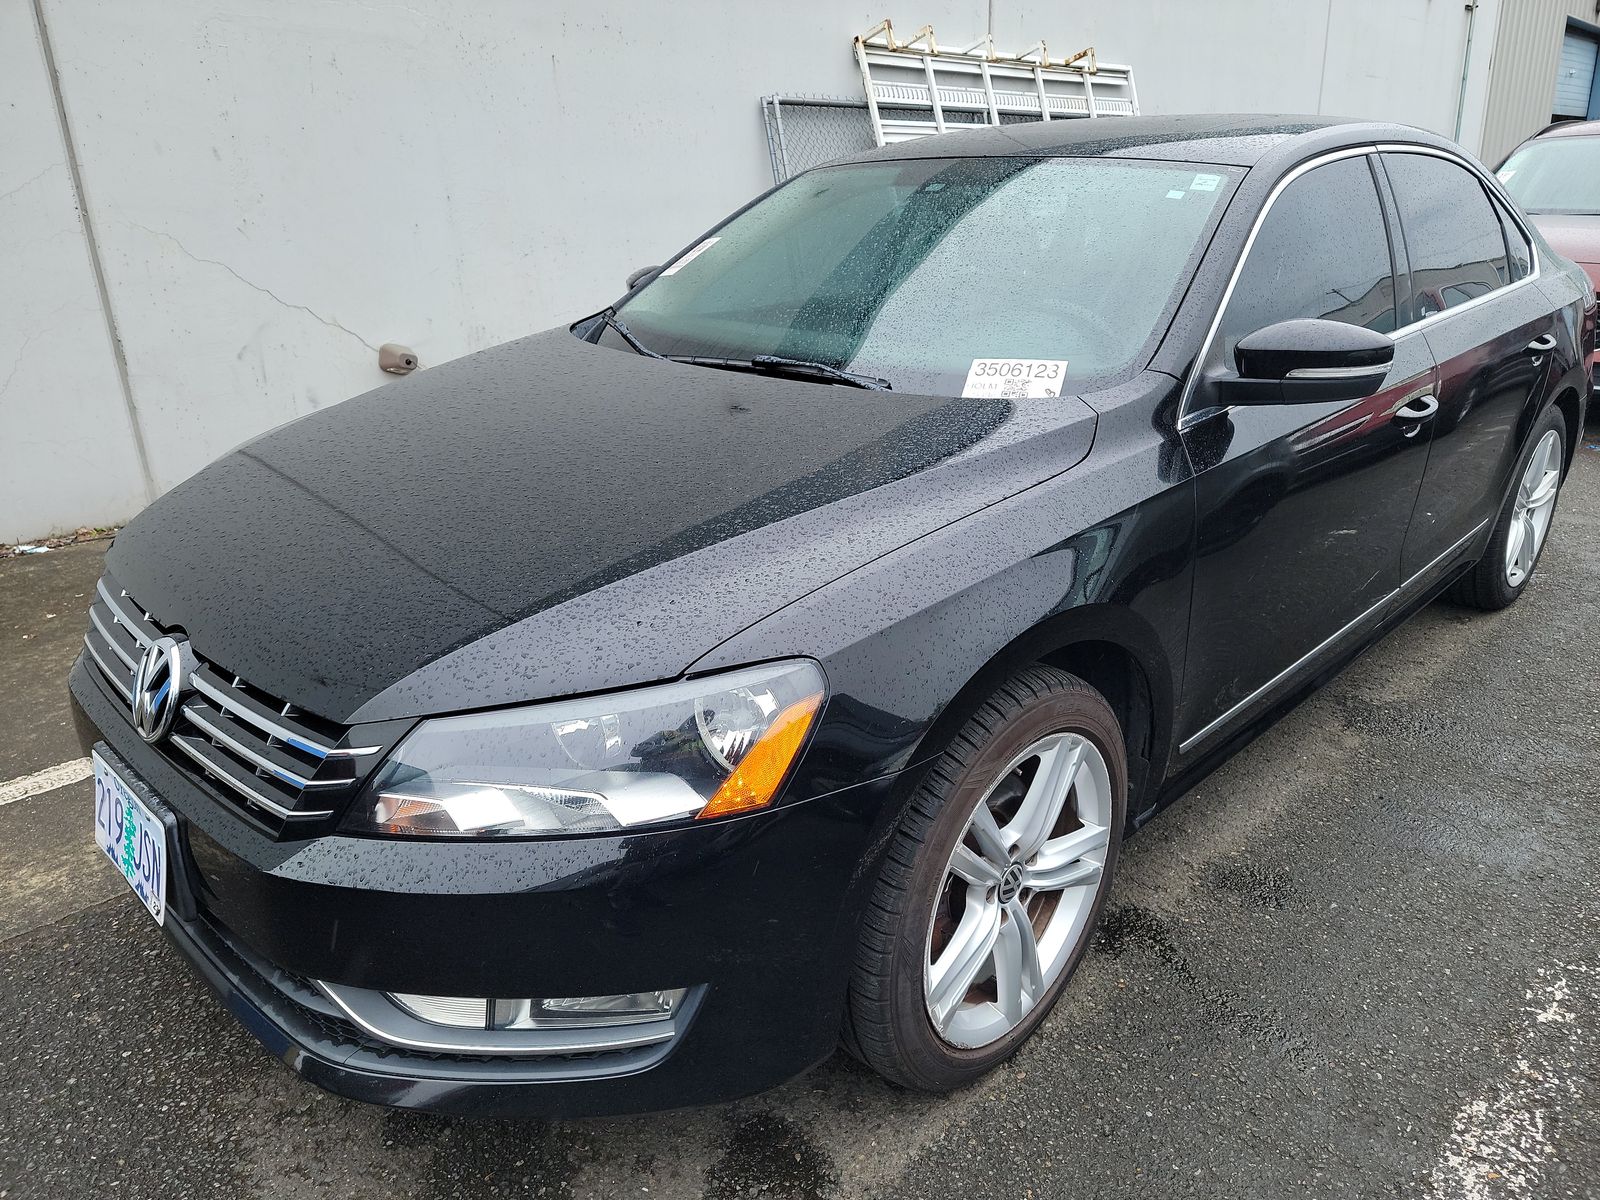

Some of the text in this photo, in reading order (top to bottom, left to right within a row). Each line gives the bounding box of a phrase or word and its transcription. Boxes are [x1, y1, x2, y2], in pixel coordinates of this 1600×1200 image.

[974, 362, 1060, 379] 3506123
[97, 777, 161, 898] 219 JSN
